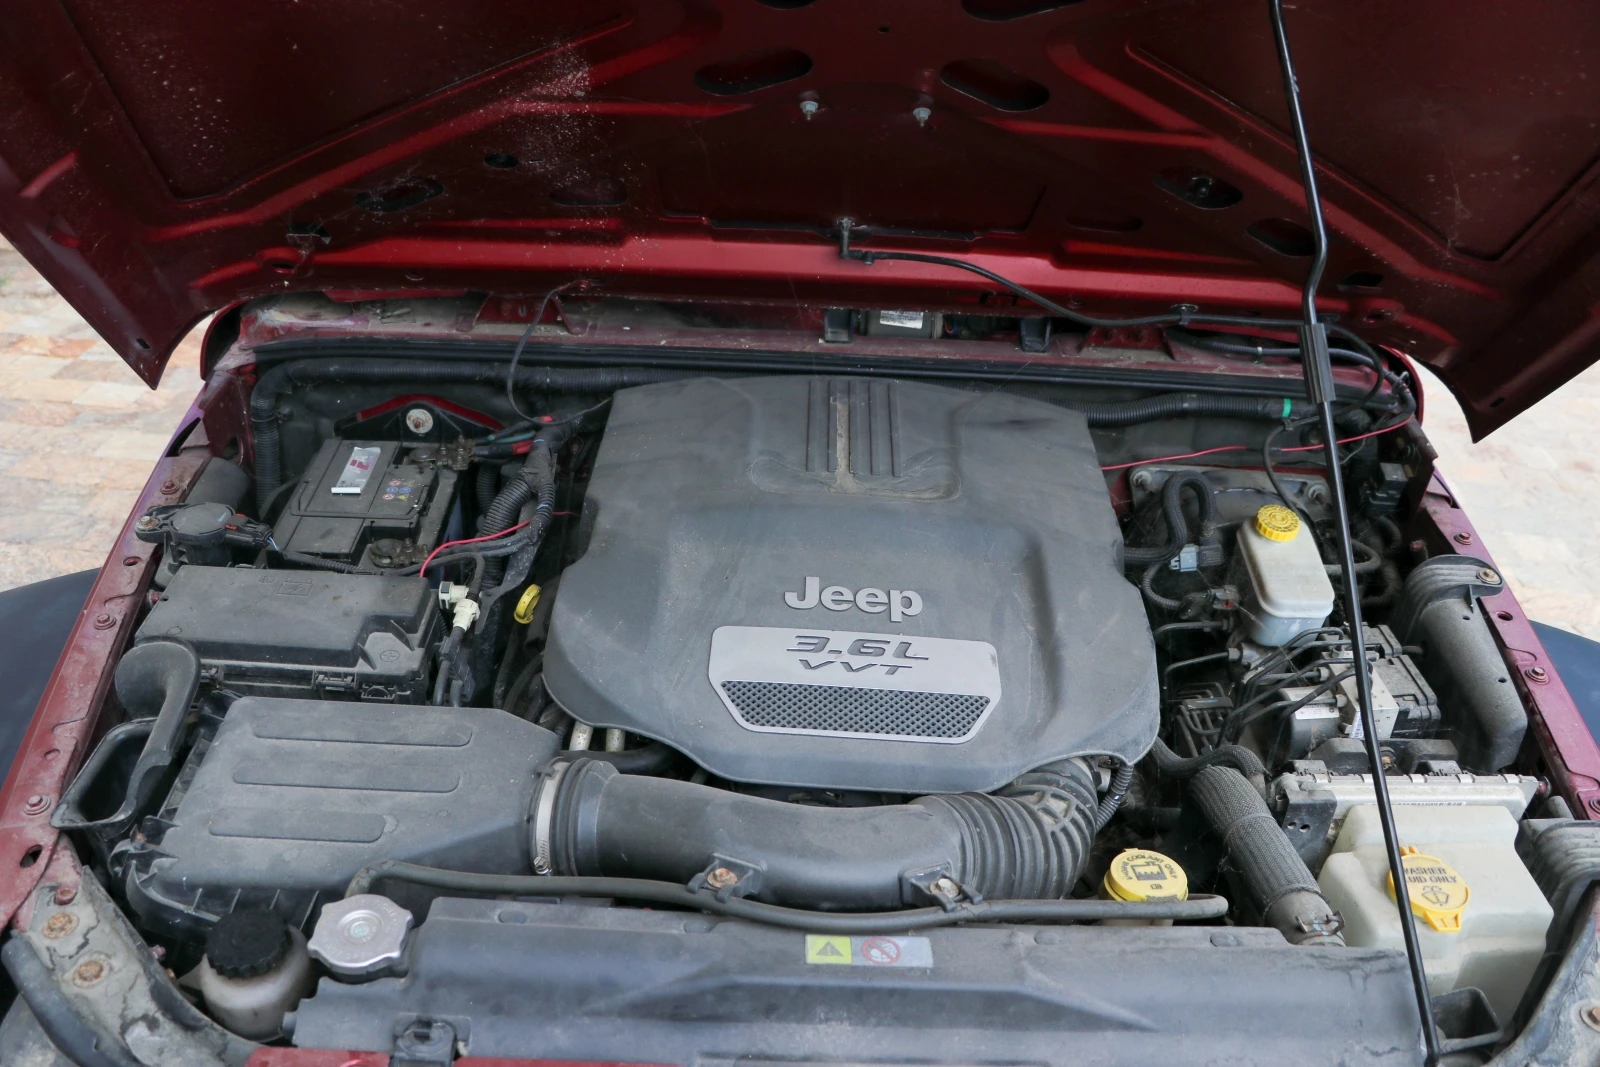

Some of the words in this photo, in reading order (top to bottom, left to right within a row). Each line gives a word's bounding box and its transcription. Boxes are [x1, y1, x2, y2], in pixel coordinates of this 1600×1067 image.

[784, 576, 924, 623] Jeep
[786, 635, 930, 660] 3.6L
[798, 658, 913, 676] VVT
[1126, 854, 1165, 864] COOLANT
[1164, 863, 1178, 879] ONLY
[1429, 875, 1457, 883] ONLY
